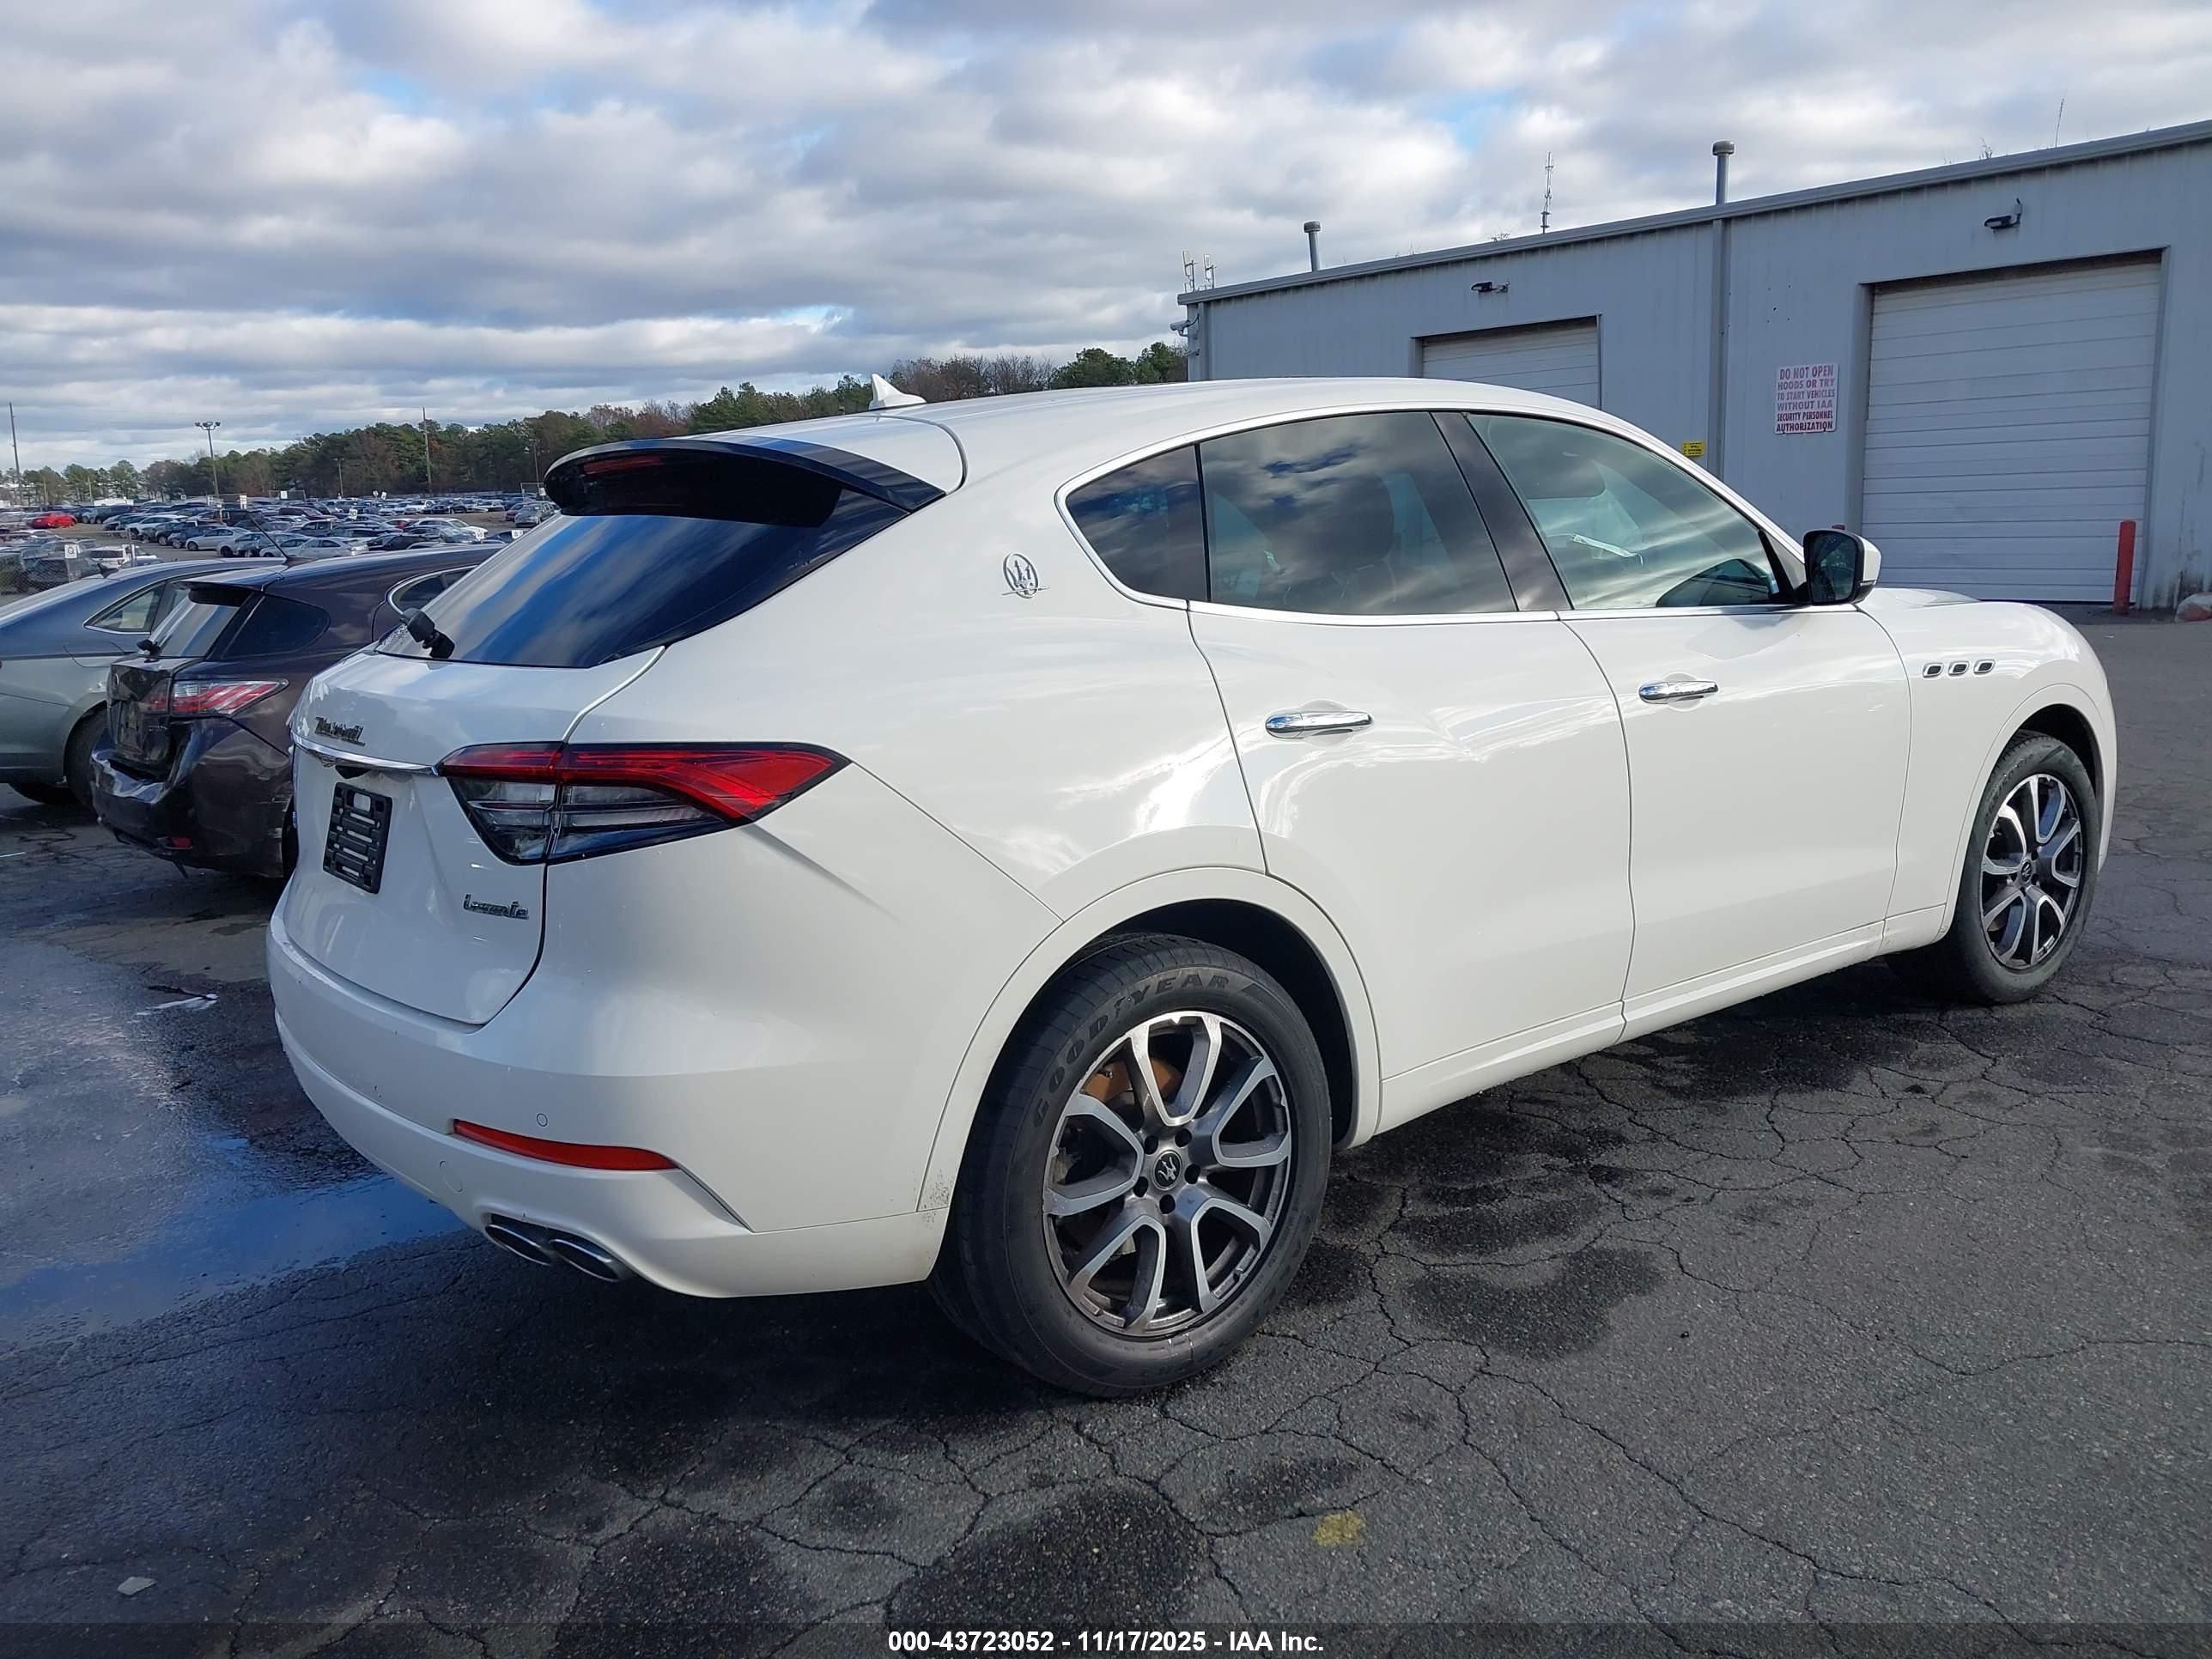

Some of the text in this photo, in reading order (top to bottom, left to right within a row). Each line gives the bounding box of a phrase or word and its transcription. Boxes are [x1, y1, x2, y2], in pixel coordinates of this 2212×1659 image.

[1780, 365, 1833, 380] DO NOT OPEN
[1778, 379, 1834, 391] HOODS OR TRY
[1786, 392, 1805, 401] START
[1807, 389, 1835, 398] VEHICLES
[1778, 400, 1832, 411] WITHOUT IAA
[1778, 410, 1833, 422] SECURITY PERSONNEL
[1777, 422, 1833, 432] AUTHORIZATION
[1032, 972, 1231, 1128] GOODYEAR
